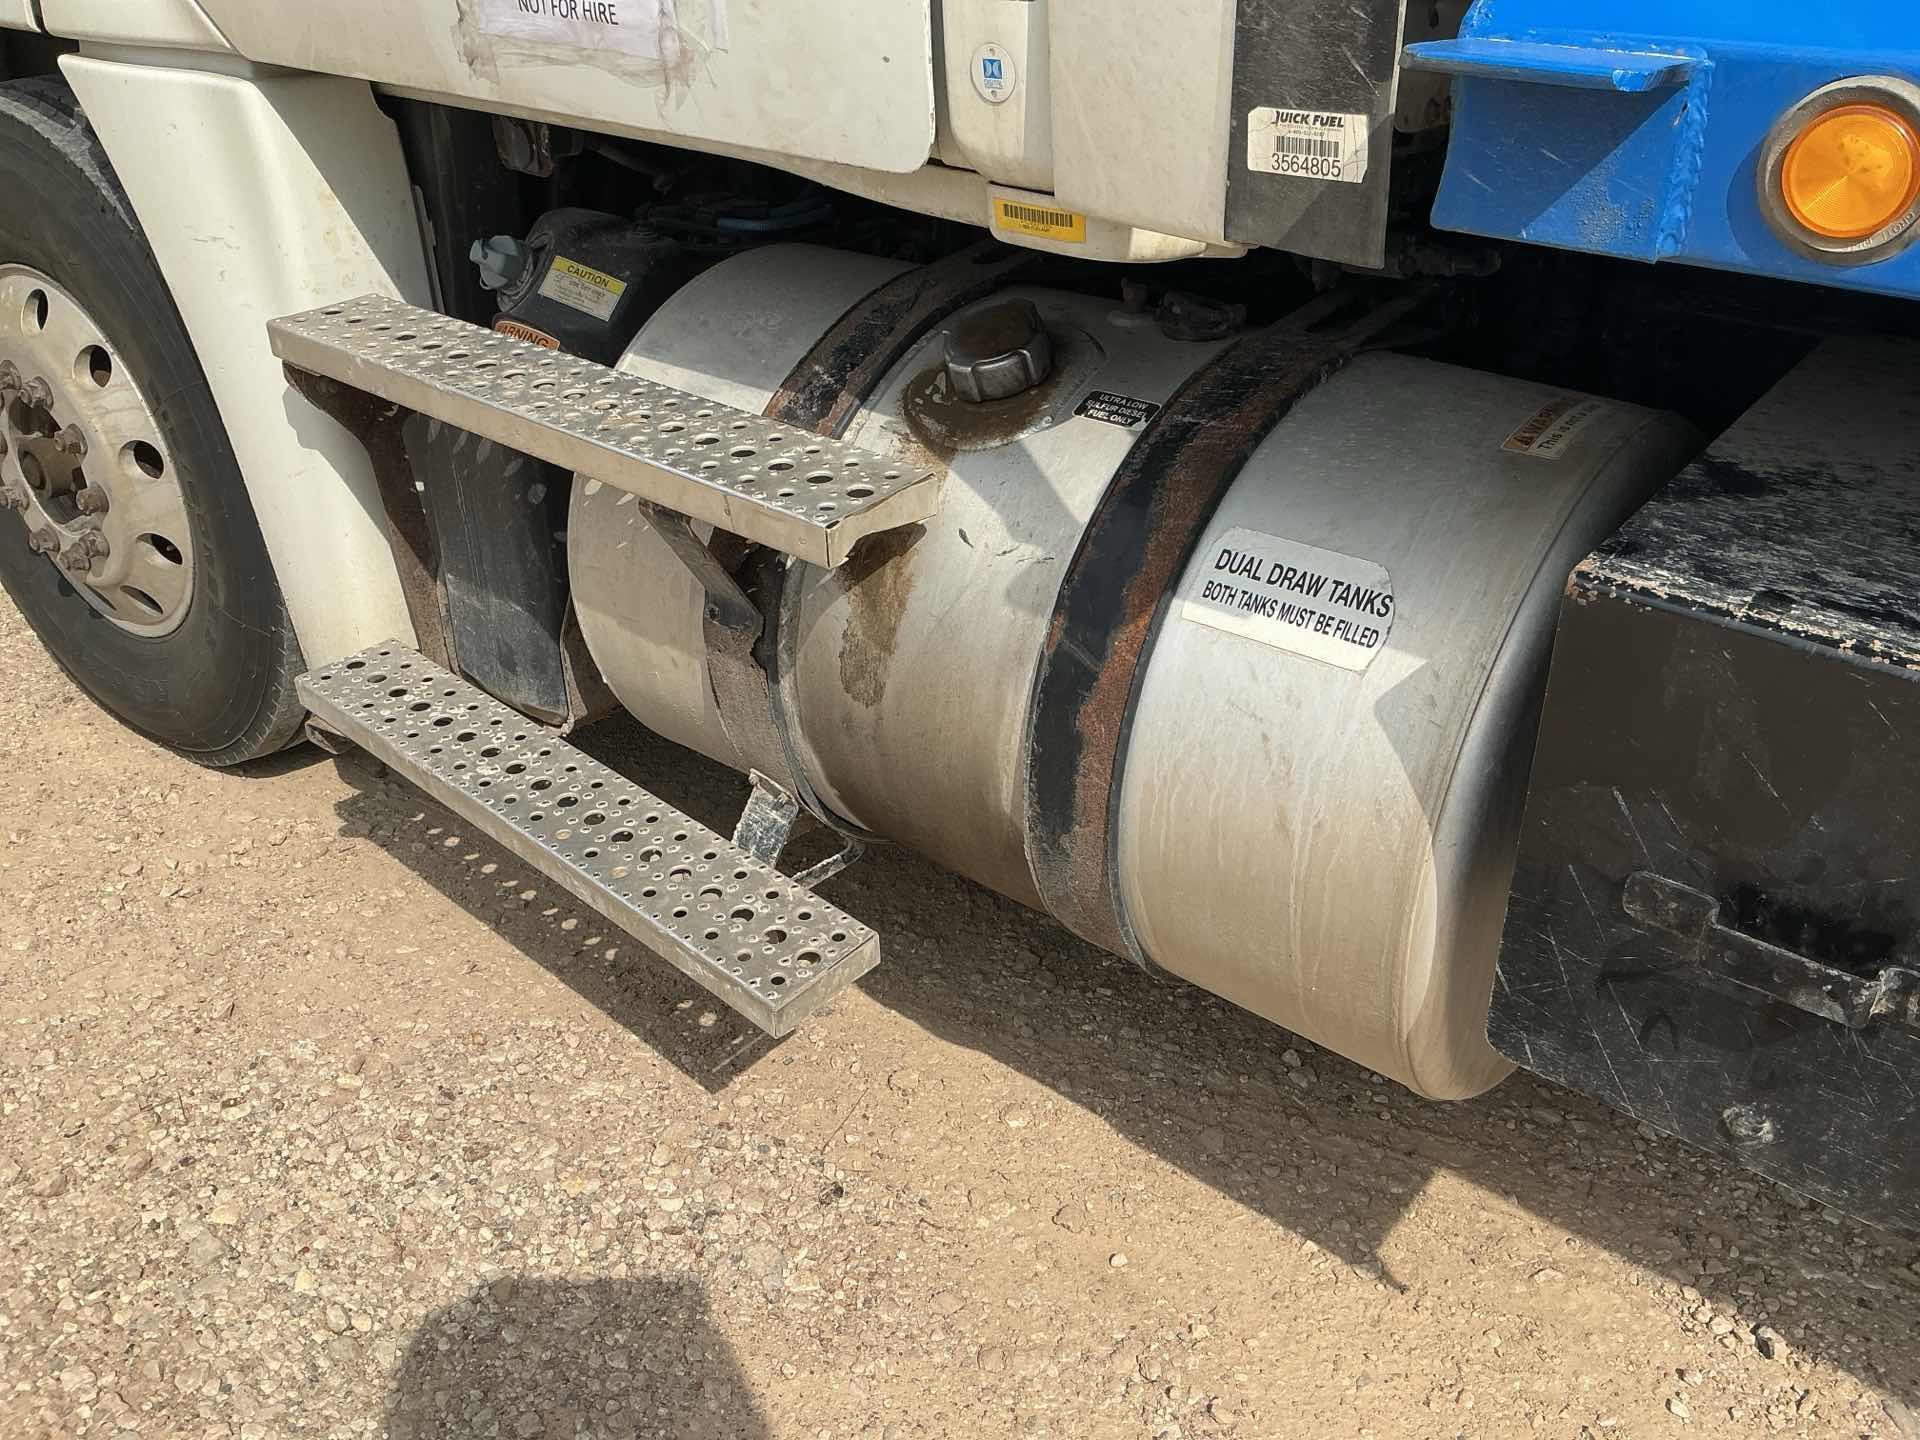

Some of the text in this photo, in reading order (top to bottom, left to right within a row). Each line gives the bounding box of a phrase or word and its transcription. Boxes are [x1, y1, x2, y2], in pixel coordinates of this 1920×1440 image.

[551, 0, 579, 20] FOR
[582, 2, 619, 25] HIRE
[1312, 114, 1344, 128] FUEL
[1271, 153, 1341, 177] 3564805
[567, 265, 610, 288] CAUTION
[1086, 400, 1147, 419] SULFUR DIESEL
[1100, 394, 1150, 410] ULTRA LOW
[1087, 409, 1134, 424] FUEL ONLY
[1214, 548, 1394, 618] DUAL DRAW TANKS
[1202, 580, 1380, 649] BOTH TANKS MUST BE FILLED
